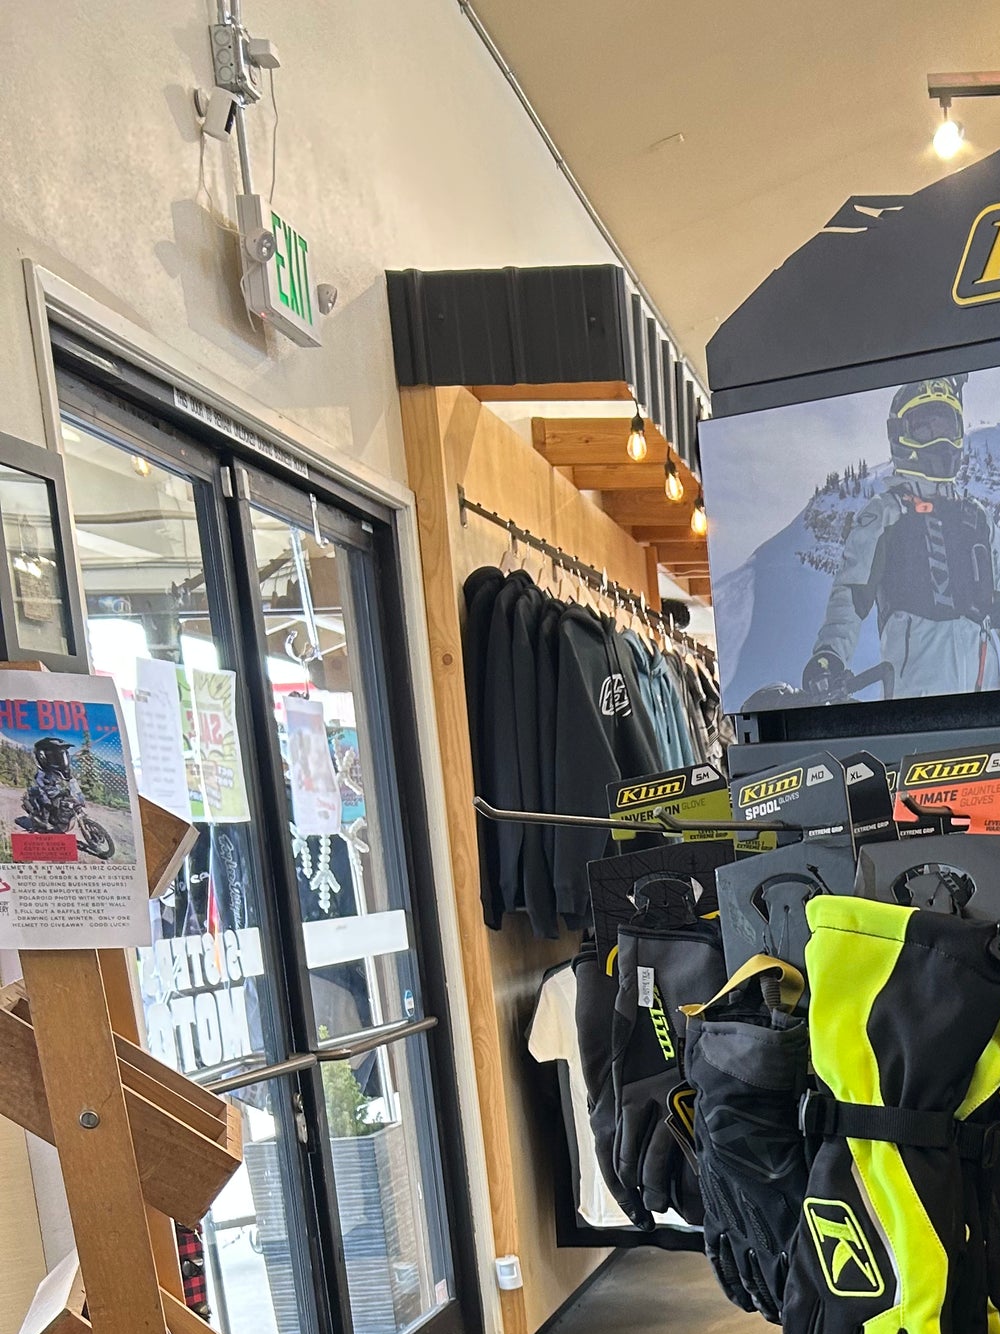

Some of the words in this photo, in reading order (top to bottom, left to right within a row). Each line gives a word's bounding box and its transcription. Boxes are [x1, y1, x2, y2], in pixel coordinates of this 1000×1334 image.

[271, 210, 312, 326] EXIT
[36, 699, 89, 731] BDR
[696, 772, 710, 781] SM
[851, 771, 862, 780] XL
[745, 799, 780, 820] SPOOL
[778, 792, 799, 805] GLOVES
[960, 796, 994, 808] GLOVES
[621, 804, 680, 822] INVERON
[682, 798, 706, 810] GLOVE
[809, 828, 831, 837] EXTREME
[831, 826, 843, 834] GRIP
[854, 824, 877, 833] EXTREME
[877, 821, 889, 829] GRIP
